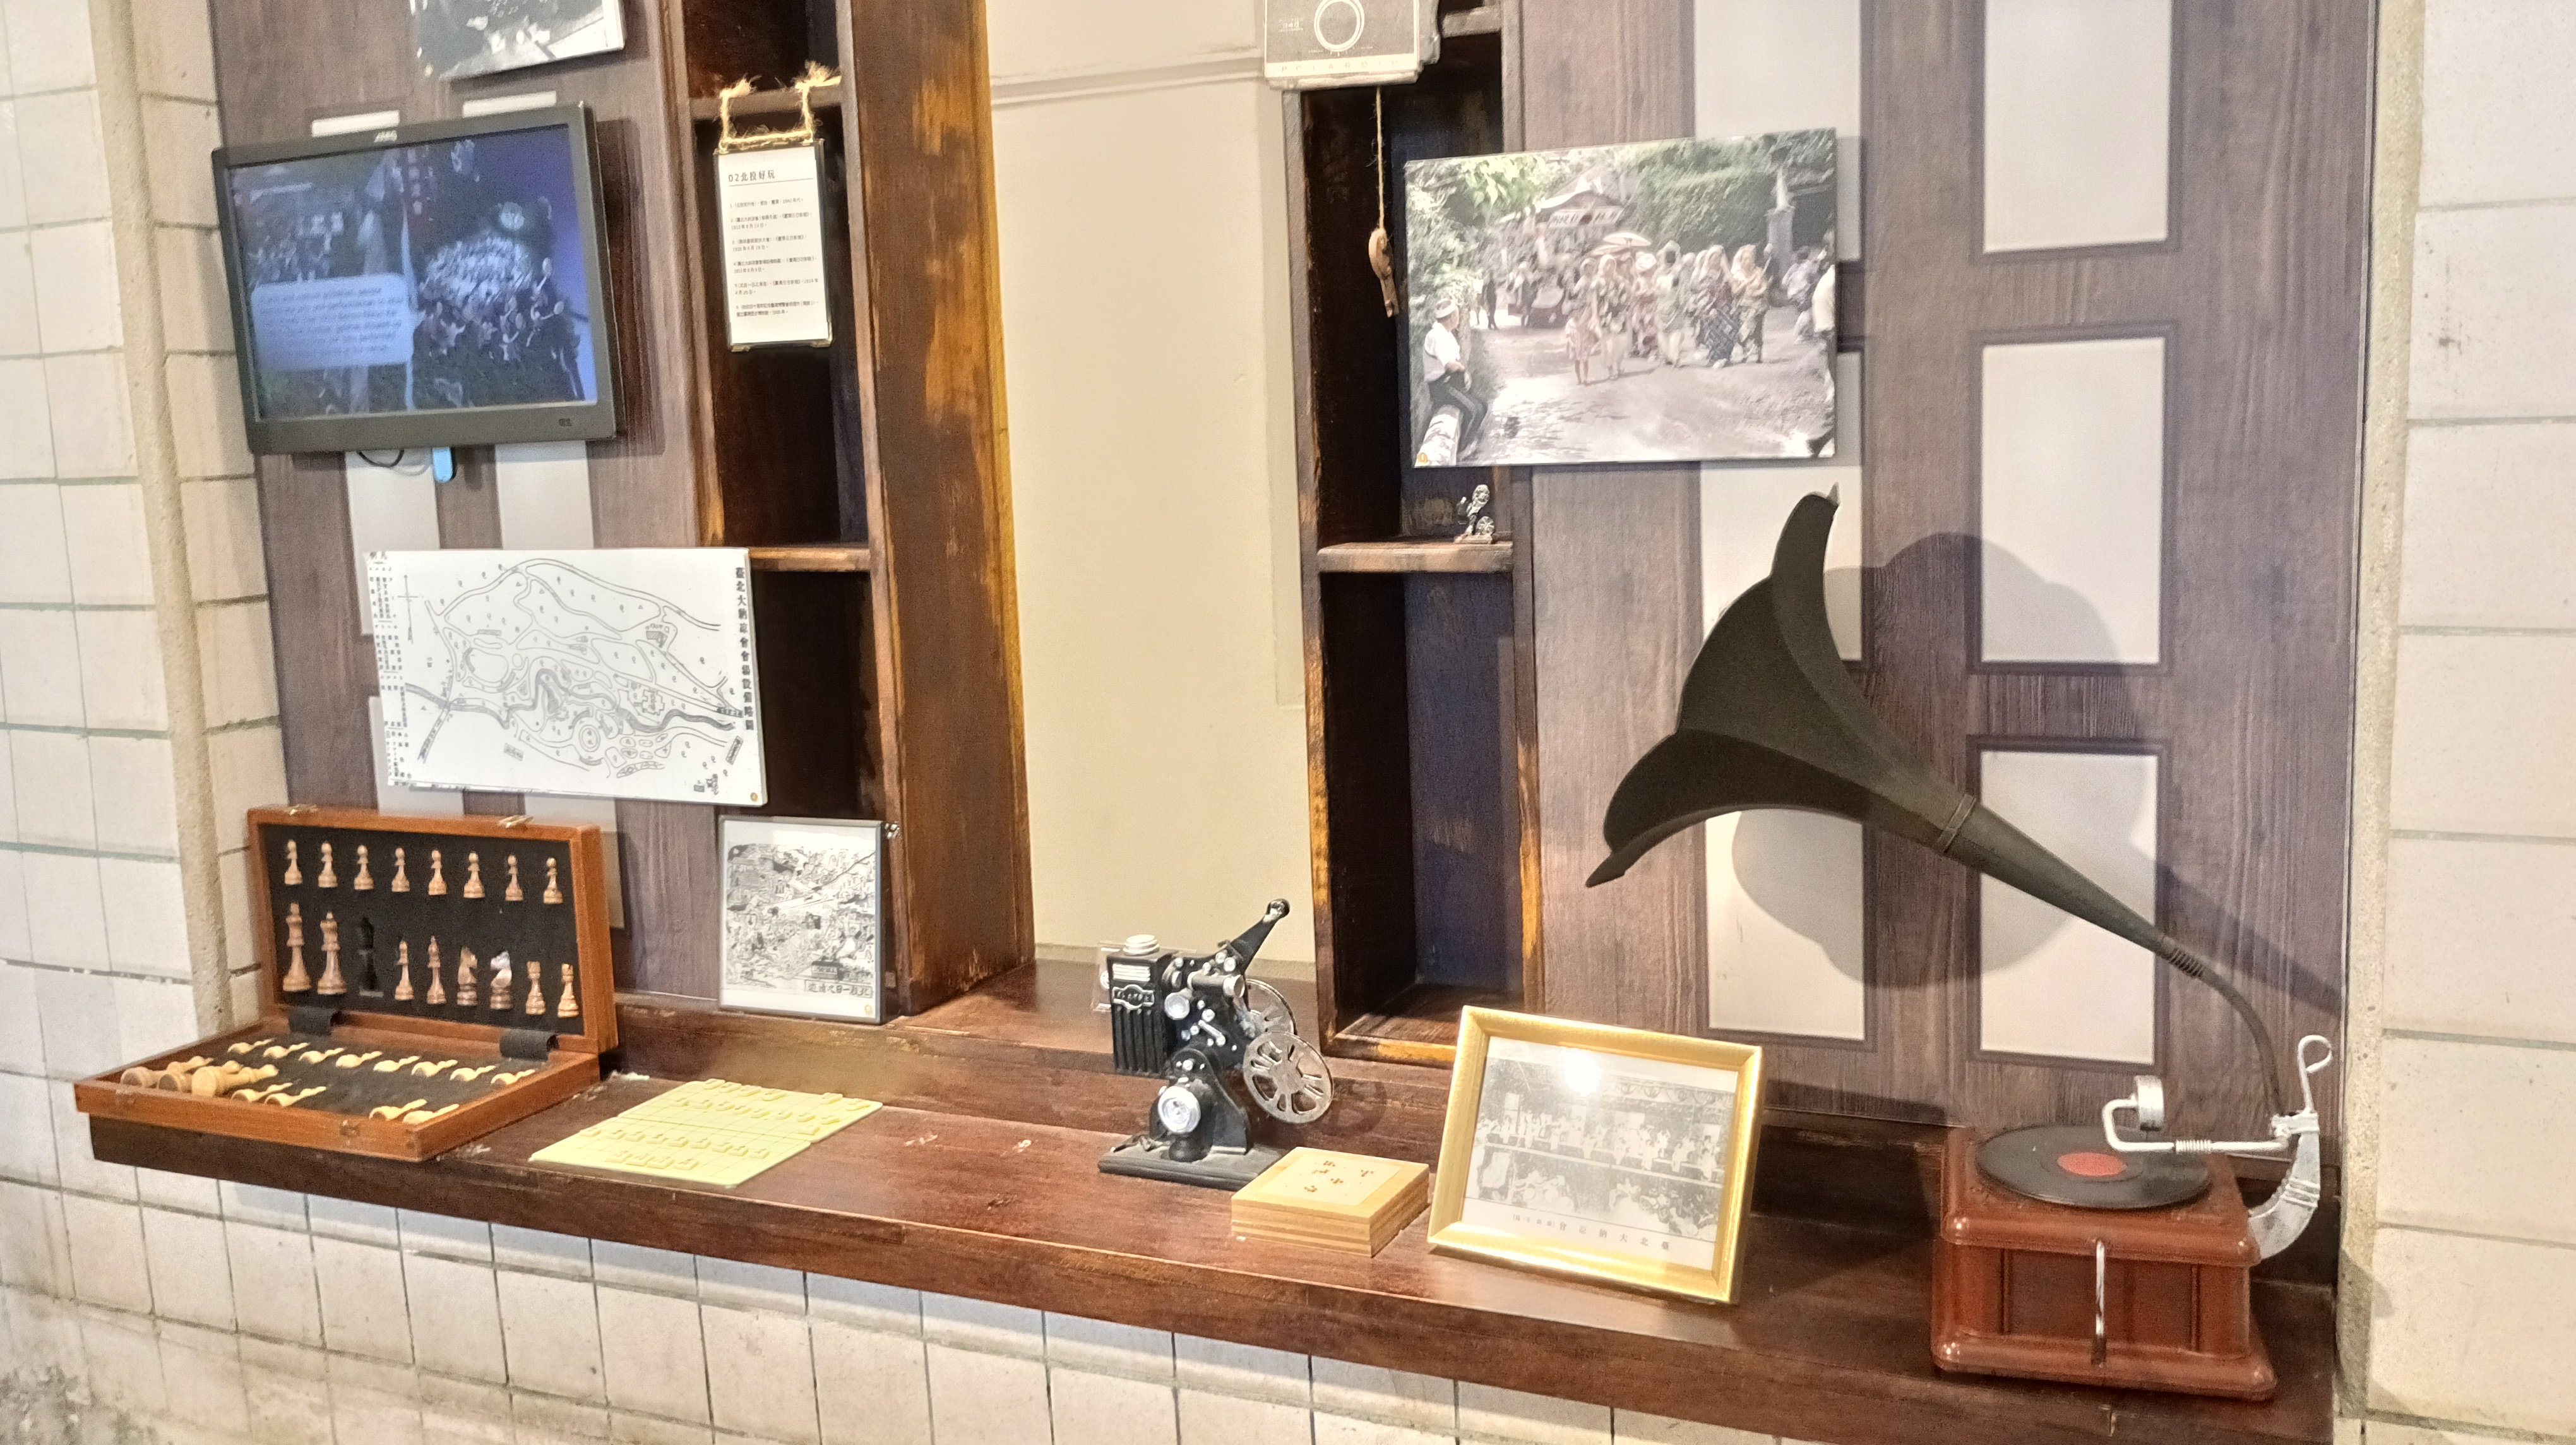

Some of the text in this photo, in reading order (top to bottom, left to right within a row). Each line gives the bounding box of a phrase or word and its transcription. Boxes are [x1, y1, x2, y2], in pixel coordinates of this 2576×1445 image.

[1282, 59, 1398, 73] POLAROID
[728, 169, 775, 183] 02北投好玩
